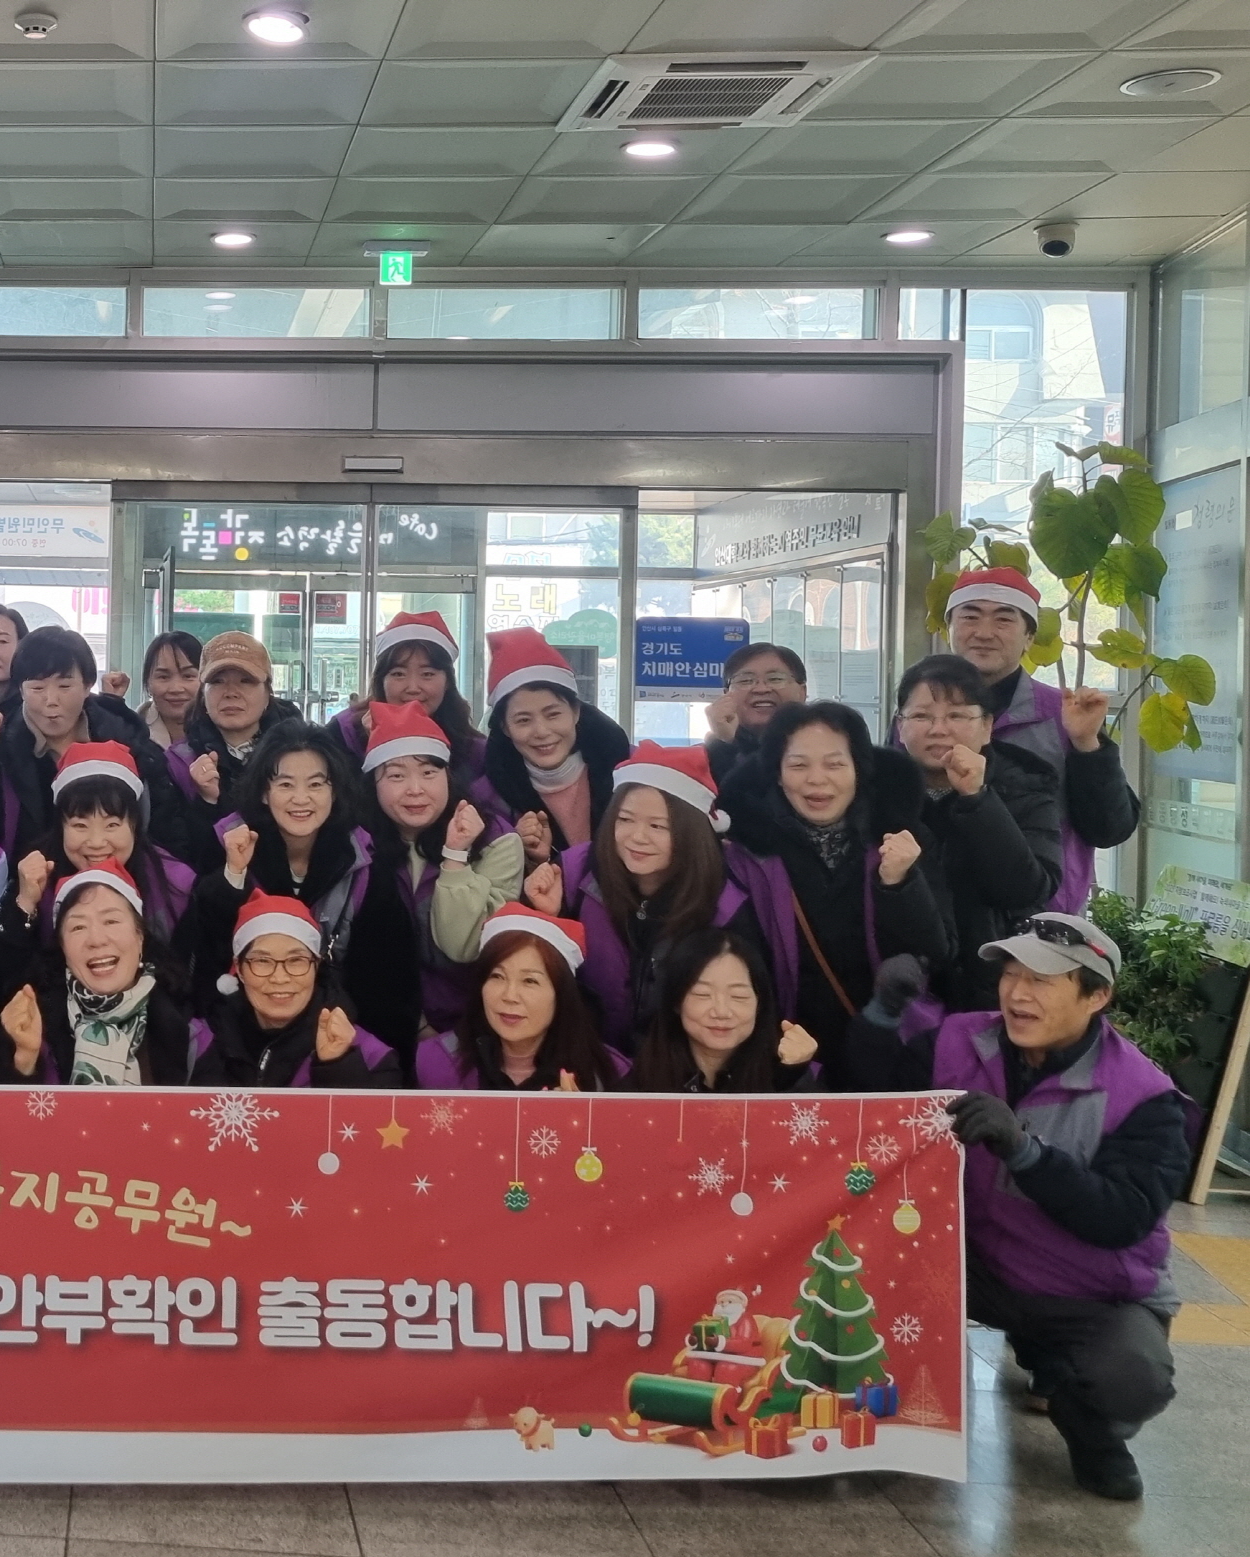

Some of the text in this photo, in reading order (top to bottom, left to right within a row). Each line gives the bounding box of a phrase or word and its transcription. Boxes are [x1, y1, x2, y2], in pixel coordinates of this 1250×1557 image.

[492, 583, 558, 615] 노래
[641, 642, 683, 656] 경기도
[258, 1275, 657, 1355] 출동합니다~!
